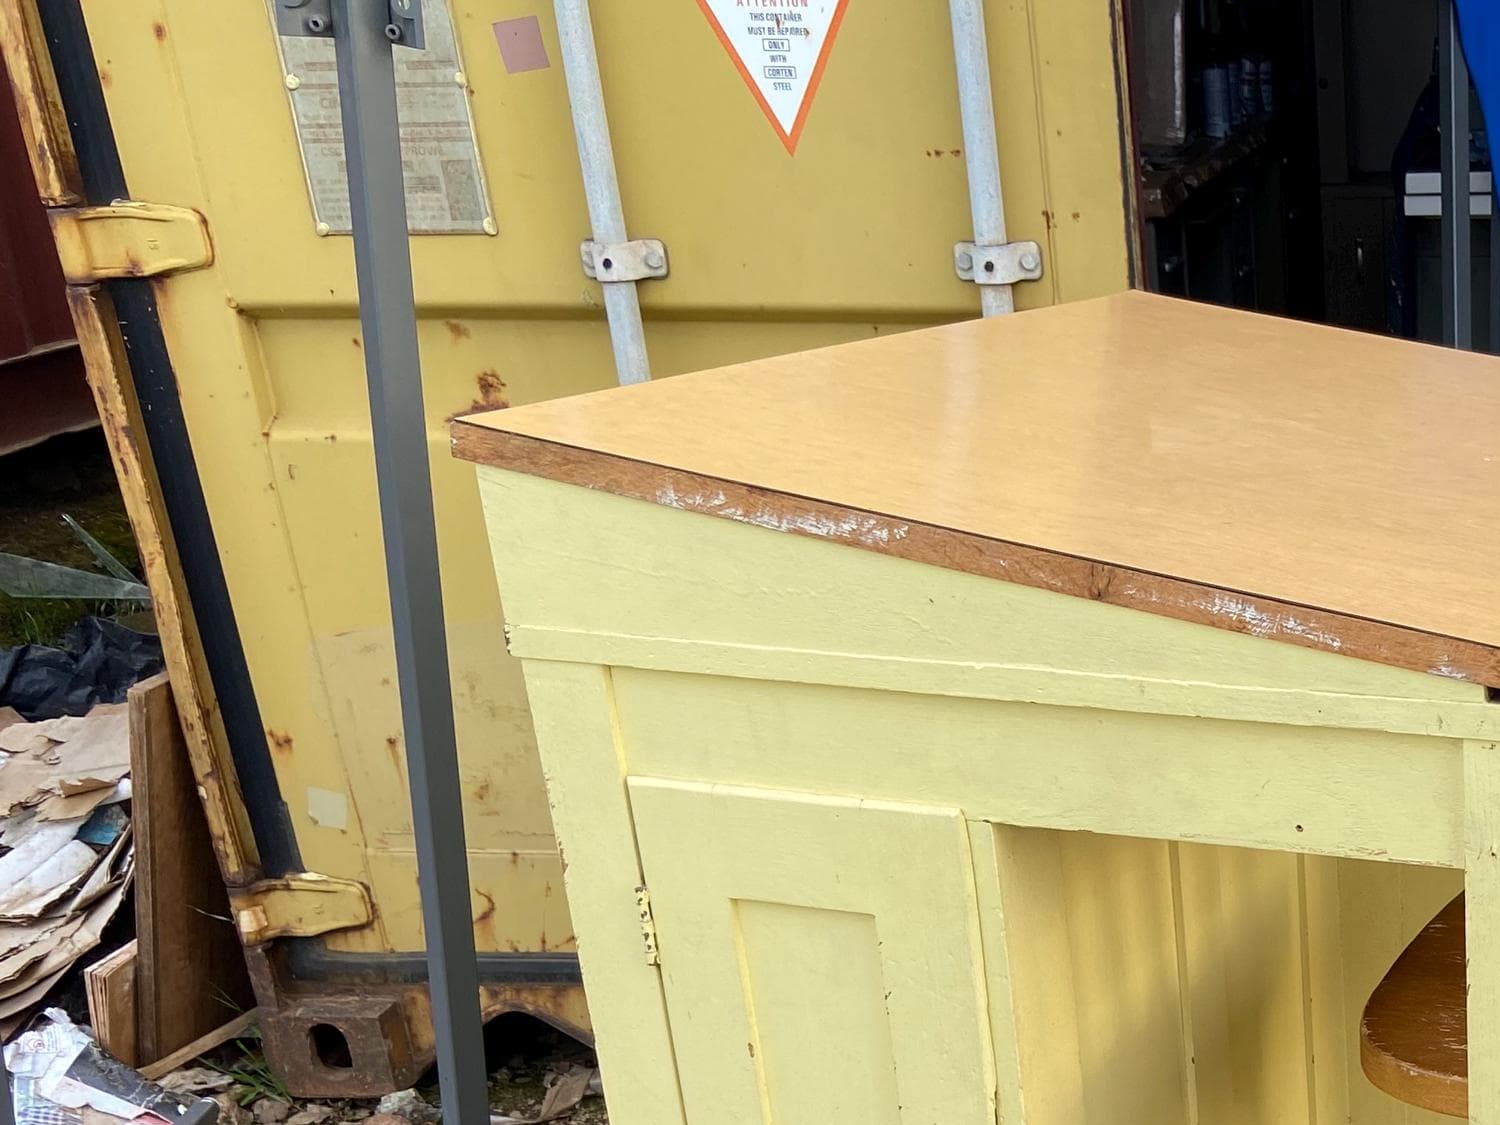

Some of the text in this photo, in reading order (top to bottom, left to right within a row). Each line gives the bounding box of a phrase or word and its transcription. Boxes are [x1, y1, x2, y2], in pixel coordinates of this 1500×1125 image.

[749, 12, 802, 22] THIS CONTAINER
[748, 26, 809, 36] MUST BE REPAIRED
[768, 41, 785, 50] ONLY
[769, 54, 787, 63] WITH
[767, 68, 793, 77] CORTEN
[773, 82, 792, 91] STEEL
